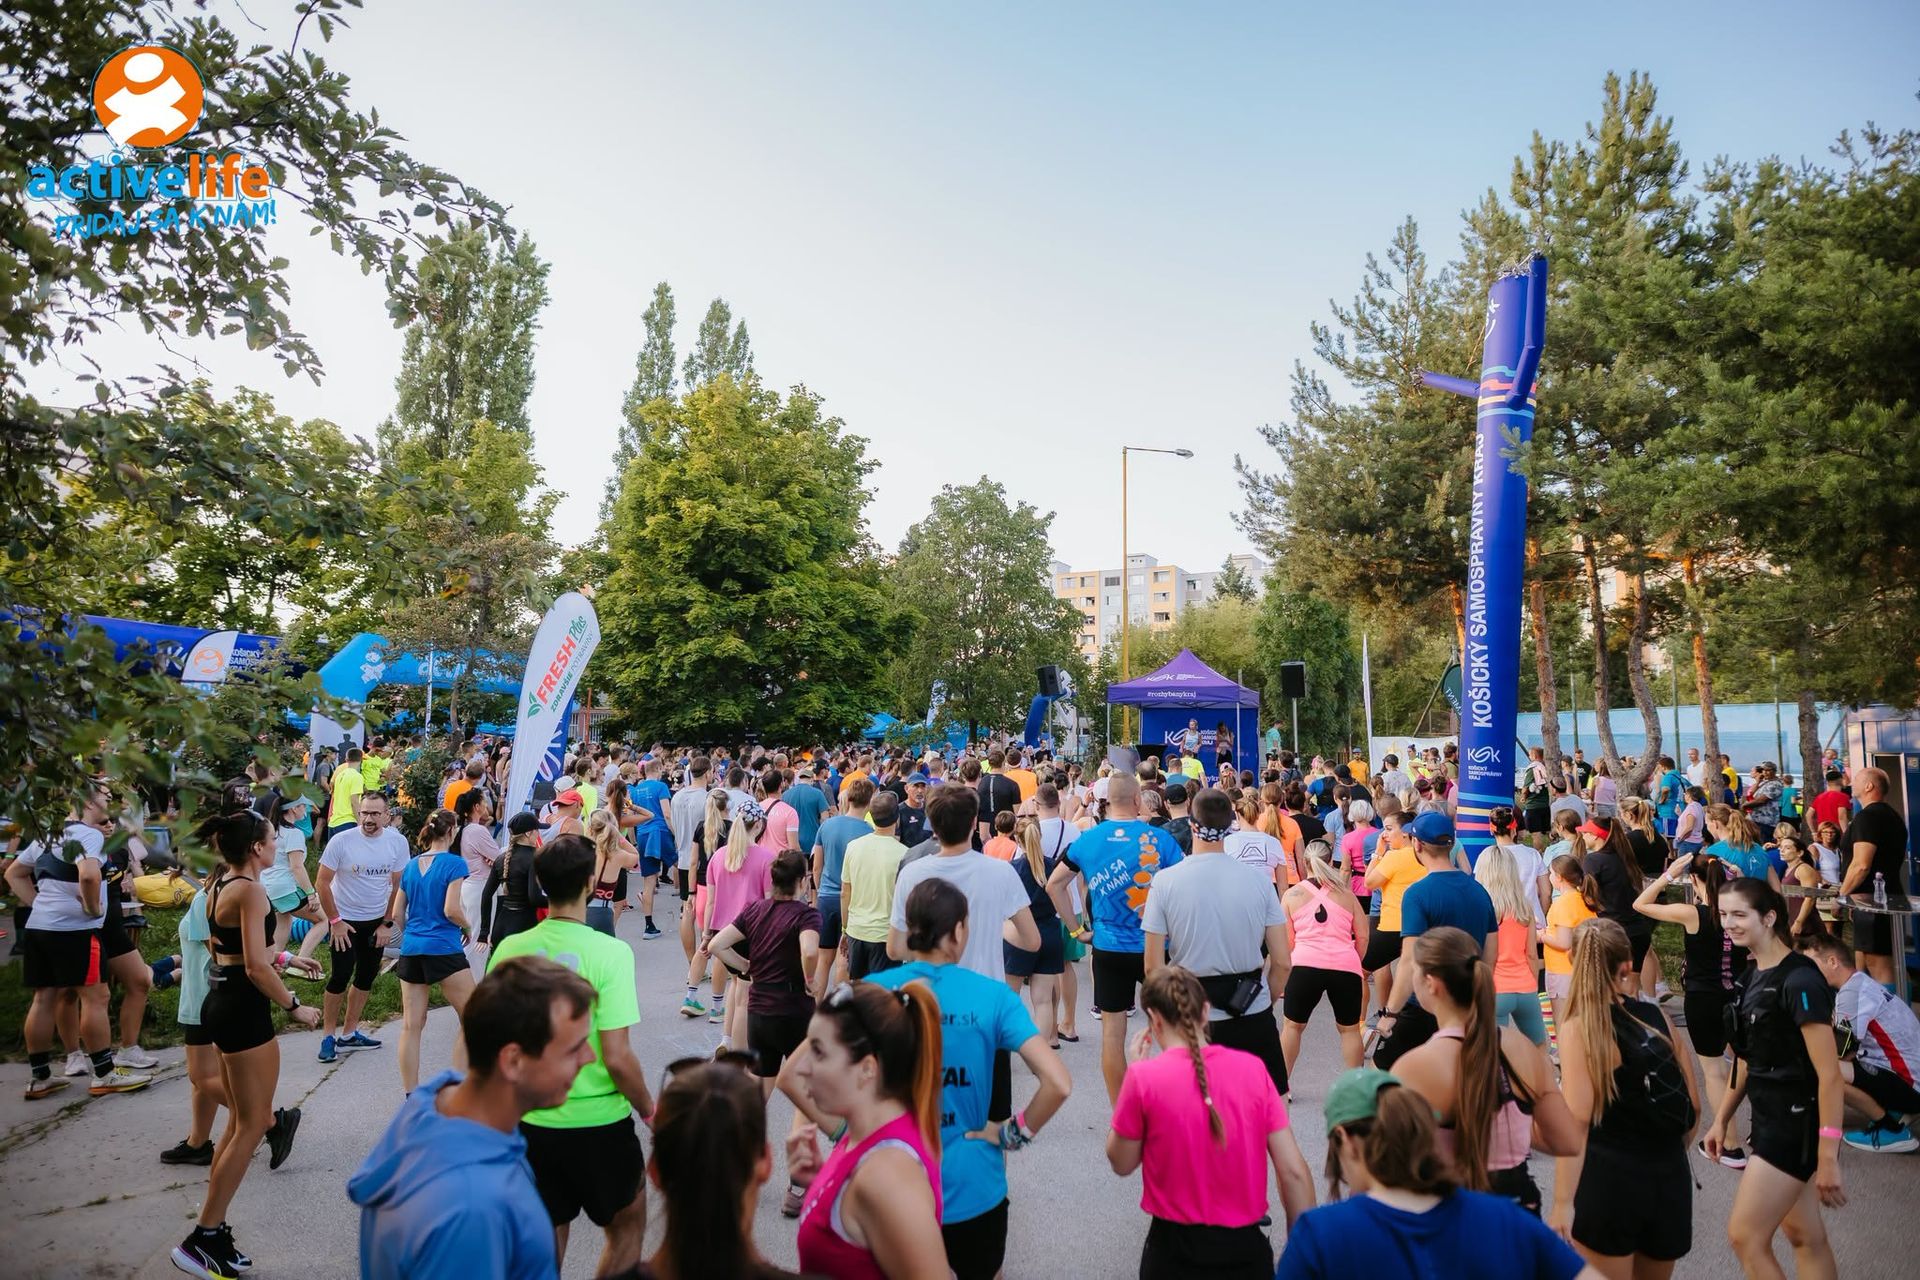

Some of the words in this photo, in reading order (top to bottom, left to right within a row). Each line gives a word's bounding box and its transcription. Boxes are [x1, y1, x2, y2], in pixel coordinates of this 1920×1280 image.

[536, 635, 577, 705] FRESH
[569, 615, 587, 641] Plus
[1467, 644, 1493, 728] KOŠICKÝ
[1110, 859, 1127, 873] SA
[941, 1011, 978, 1027] er.sk
